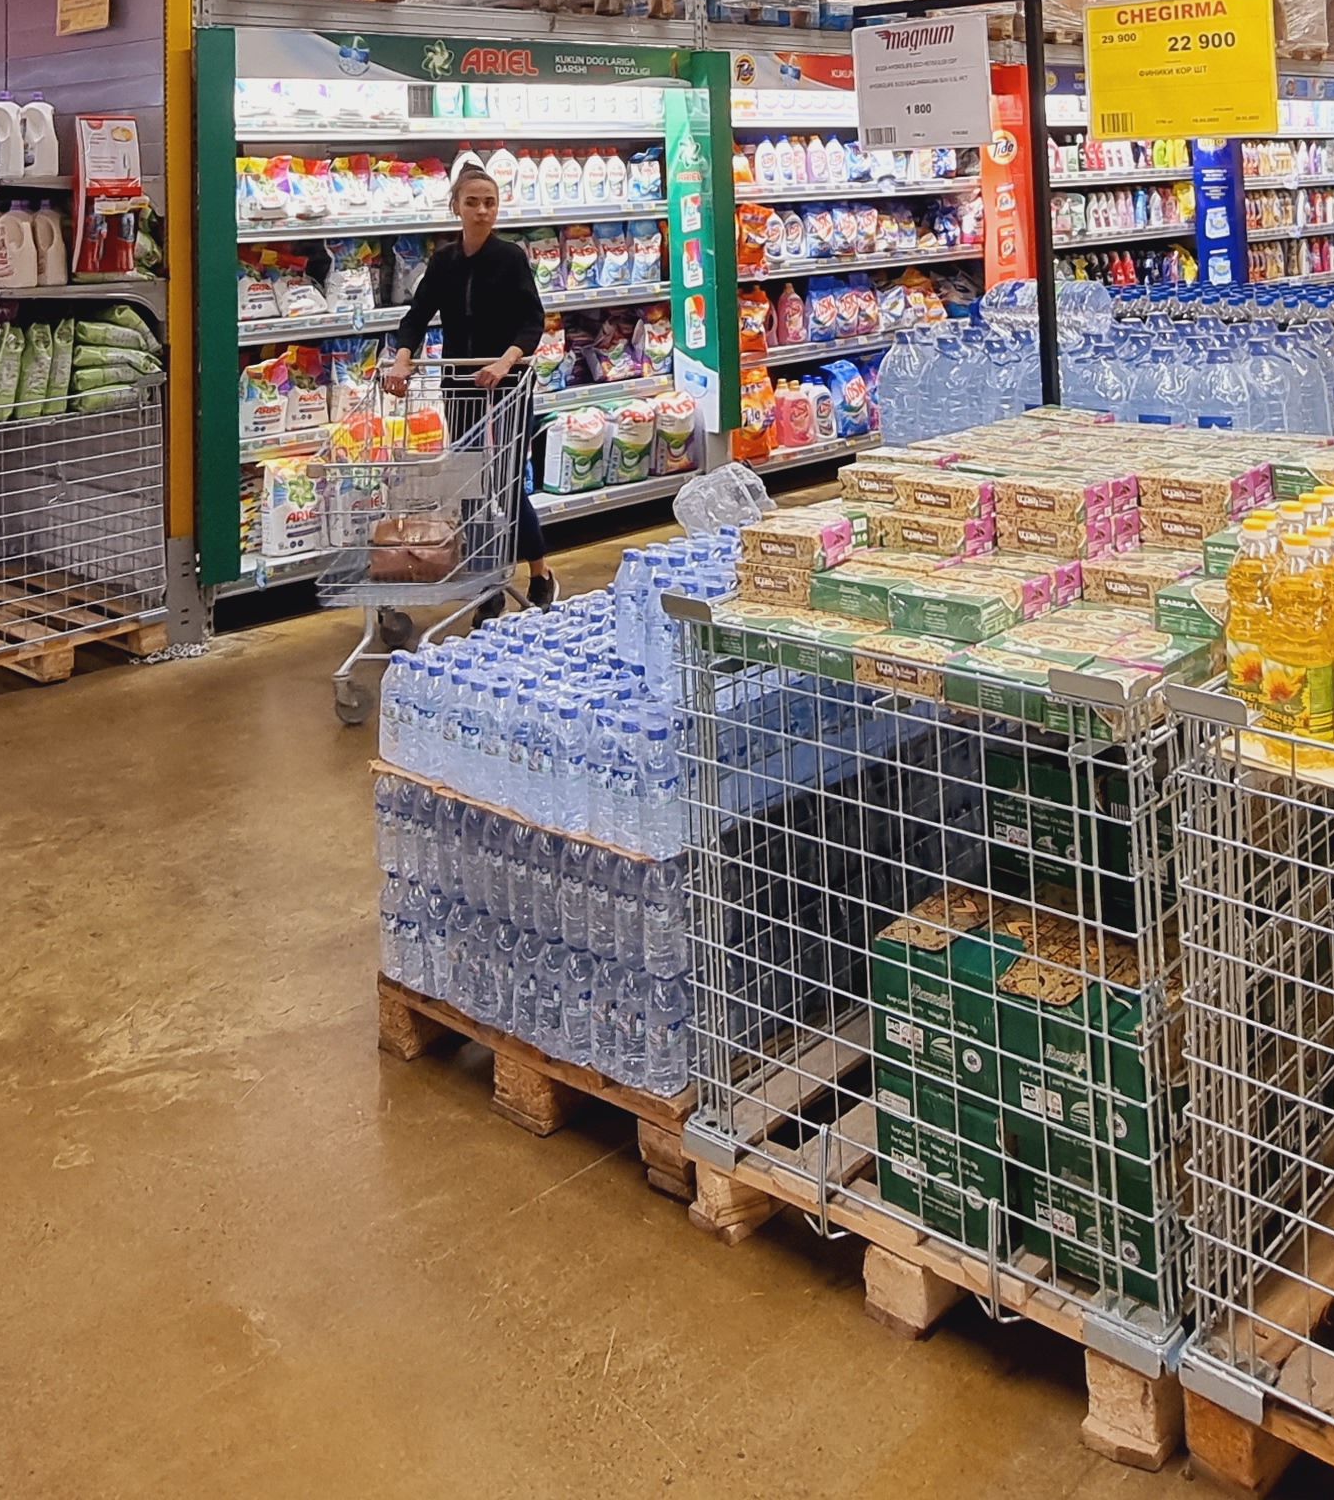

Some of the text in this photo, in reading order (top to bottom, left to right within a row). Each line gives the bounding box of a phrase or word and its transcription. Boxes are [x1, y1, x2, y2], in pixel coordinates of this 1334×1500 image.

[1116, 0, 1228, 26] CHEGIRMA
[875, 24, 955, 52] magnum
[1101, 31, 1236, 52] 29 900 22 900
[460, 47, 540, 76] ARIEL
[554, 55, 636, 66] KUKUN DOG'LARIGA
[555, 65, 588, 74] QARSHI
[614, 66, 651, 76] TOZALIGI
[1139, 65, 1208, 77] ФИНИКИ КОР ШТ
[906, 103, 932, 115] 1 800
[992, 140, 1014, 159] Tide
[286, 509, 316, 524] ARIE
